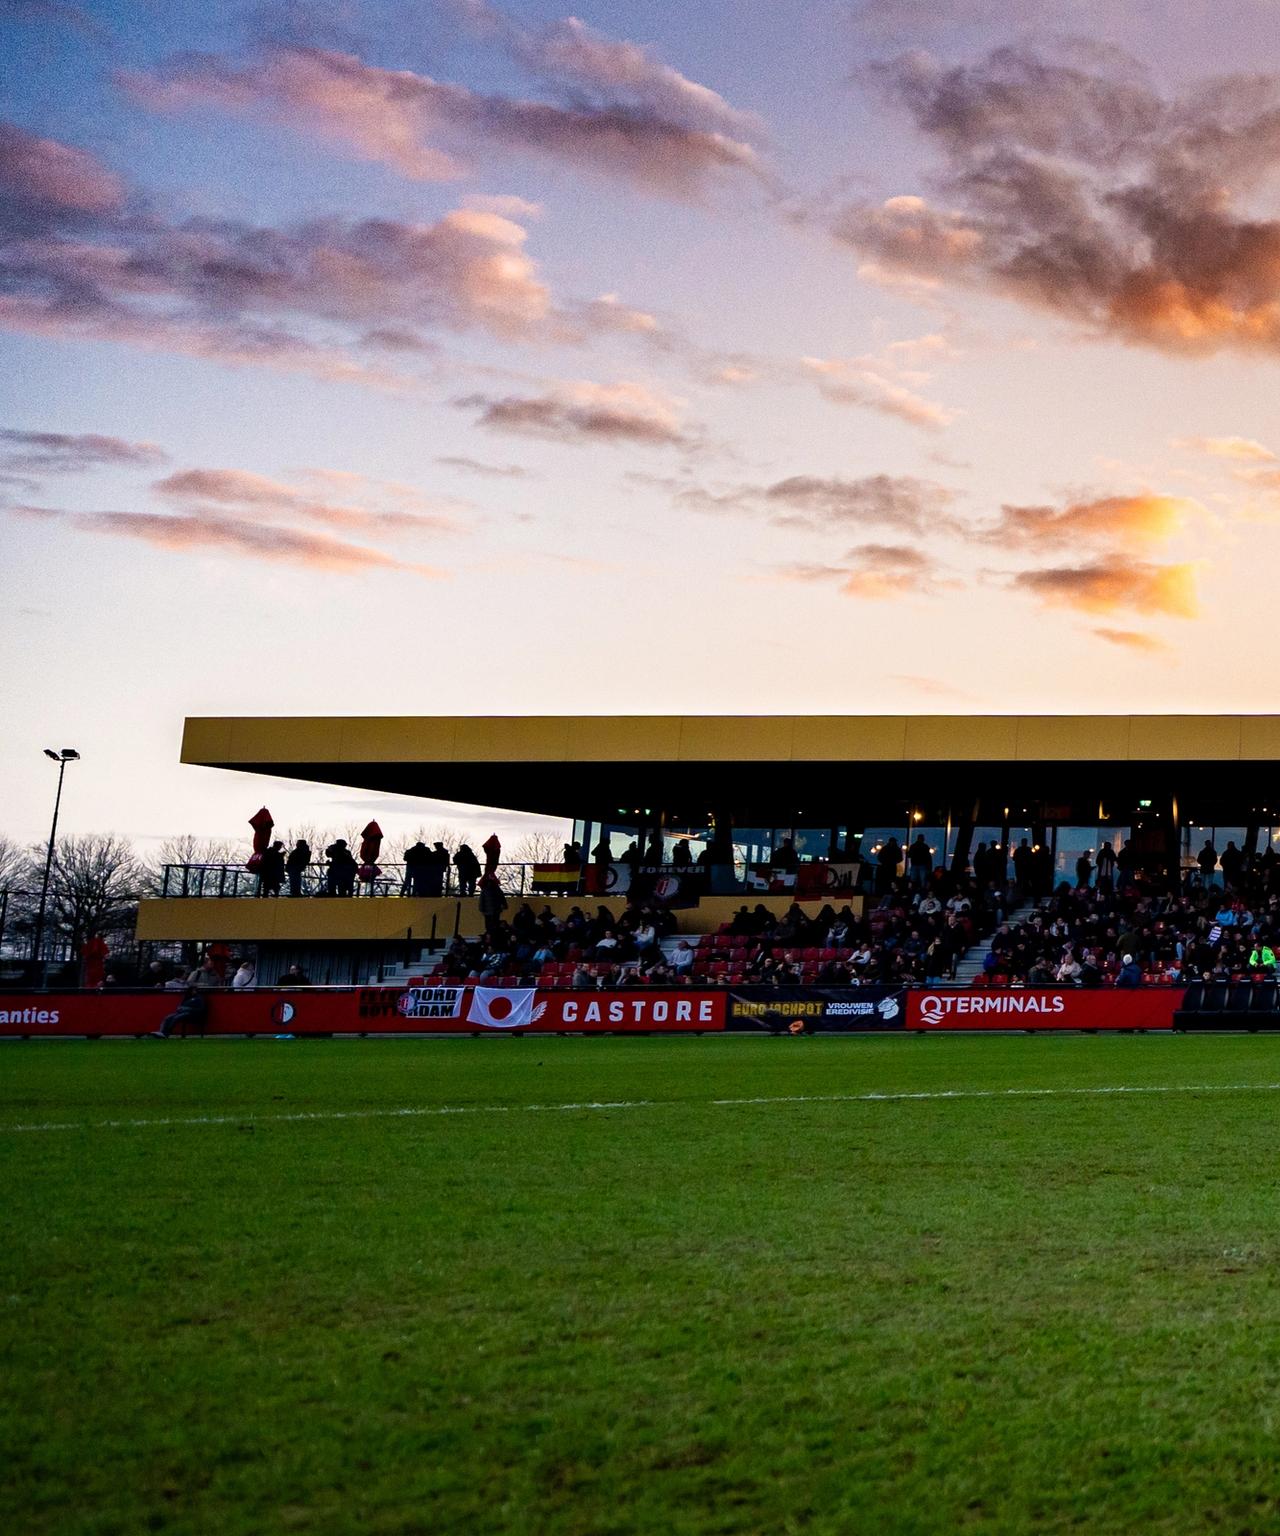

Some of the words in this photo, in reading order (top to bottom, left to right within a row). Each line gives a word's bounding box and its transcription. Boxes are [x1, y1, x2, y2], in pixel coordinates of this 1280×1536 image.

[361, 989, 458, 1001] FEYEOORD
[0, 1006, 60, 1024] anties
[562, 1000, 714, 1022] CASTORE
